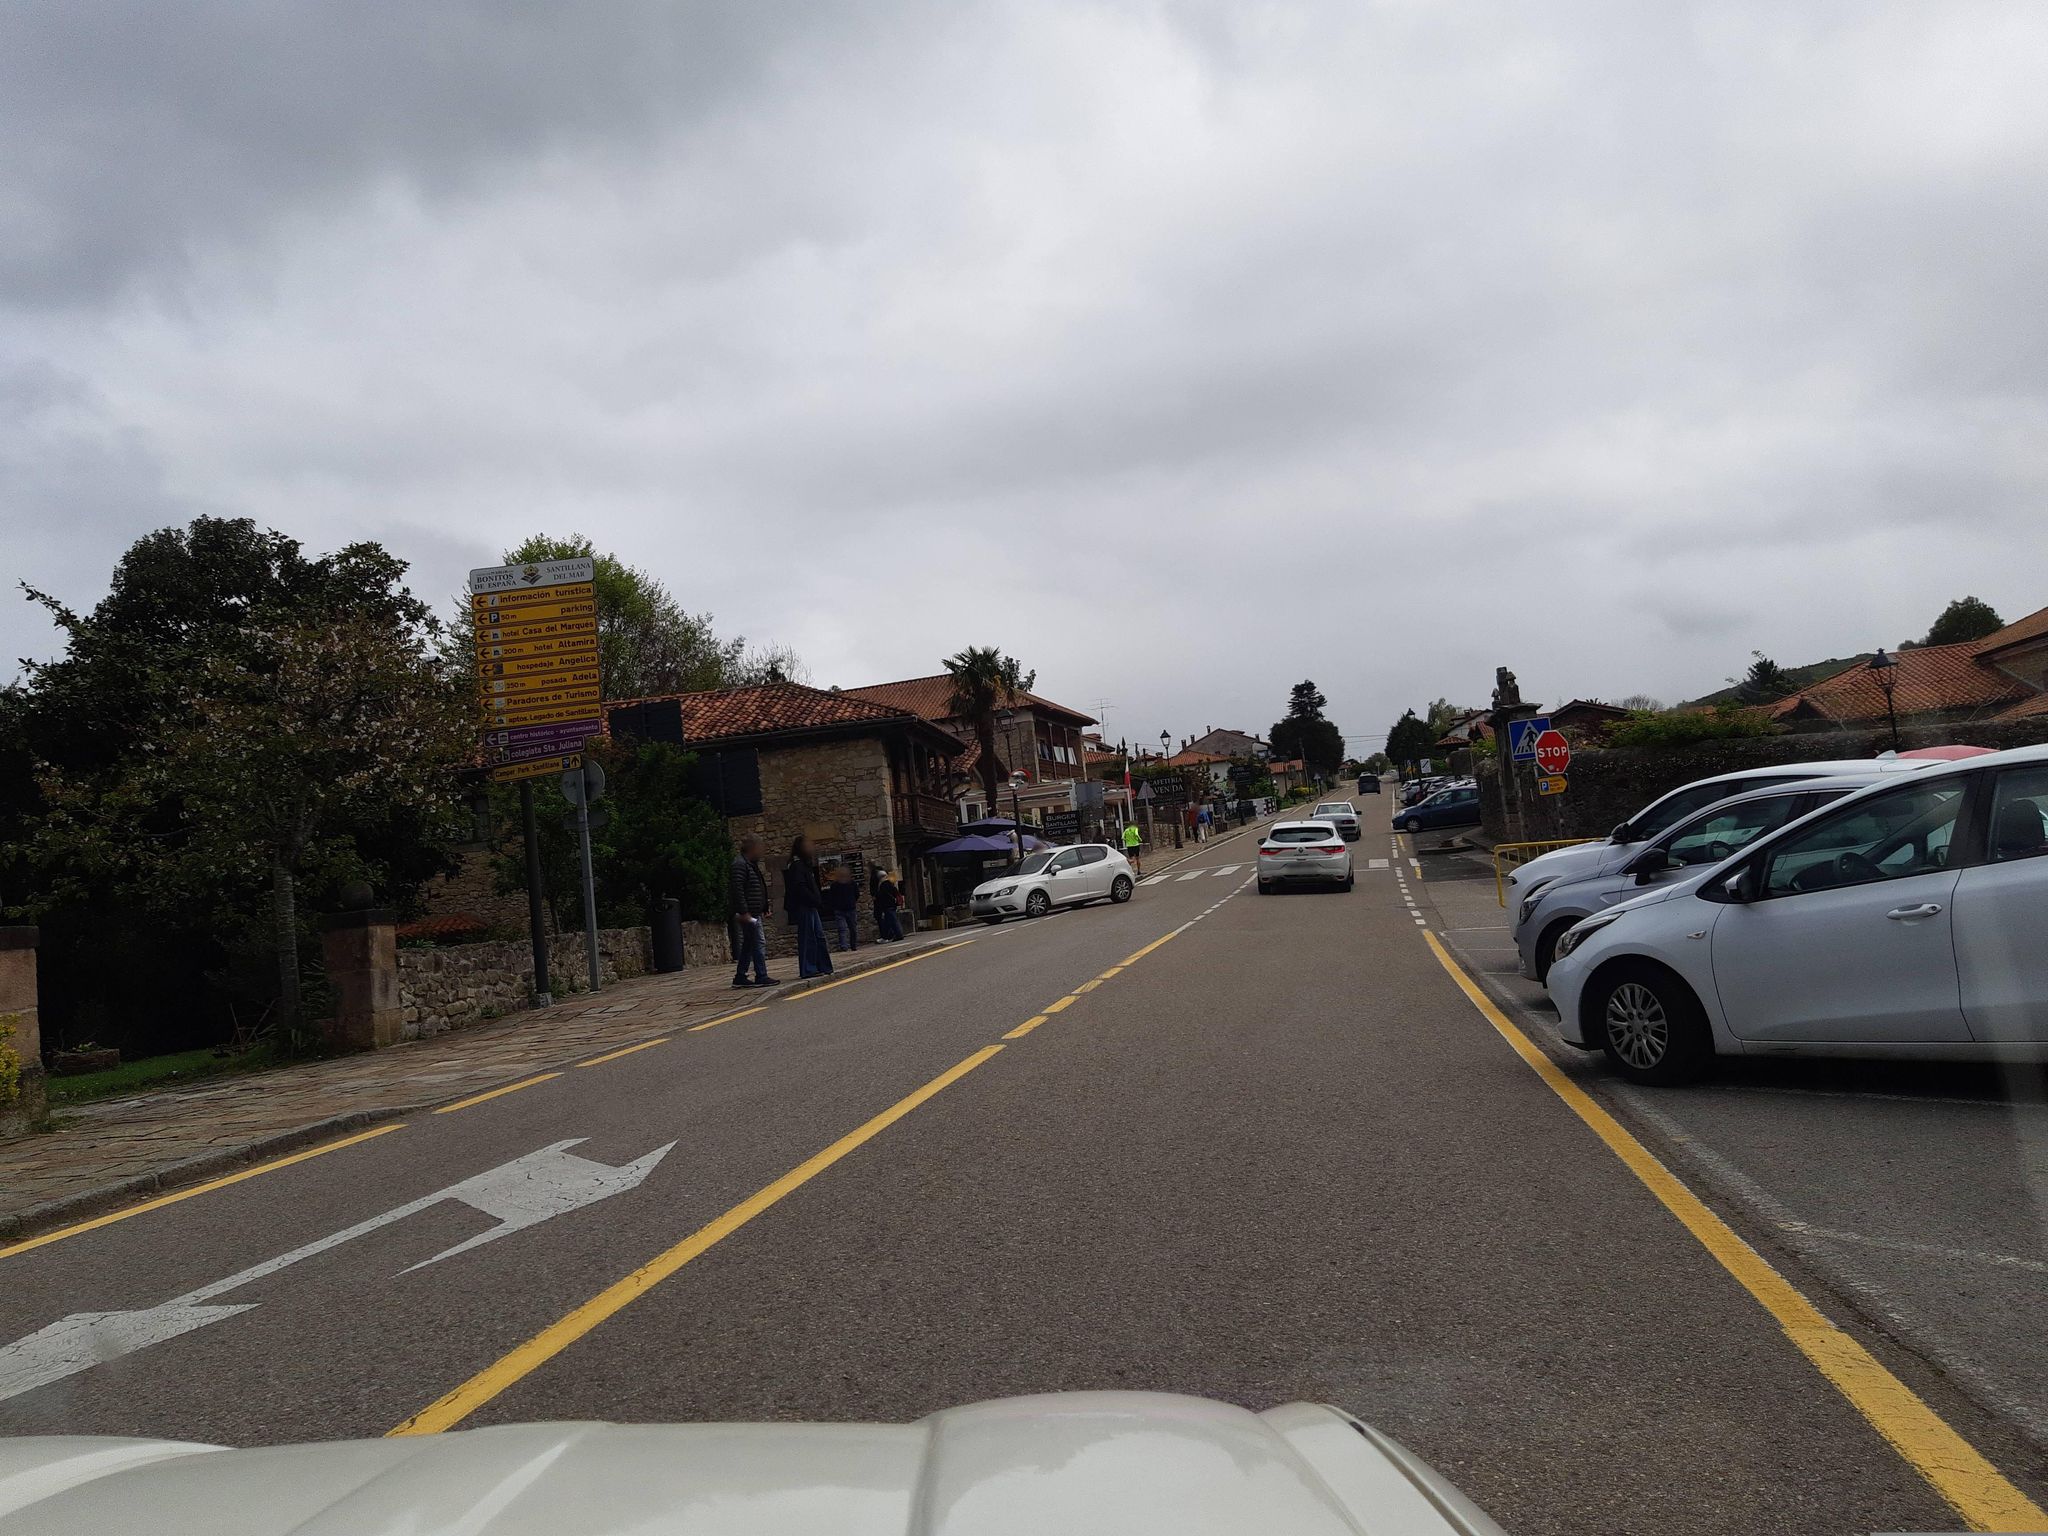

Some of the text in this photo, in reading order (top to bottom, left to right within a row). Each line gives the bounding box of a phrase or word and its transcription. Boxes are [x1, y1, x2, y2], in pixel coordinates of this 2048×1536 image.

[546, 562, 591, 573] SANTILLANA
[476, 574, 514, 583] BONITOS
[569, 571, 585, 579] MAR
[488, 579, 517, 589] ESPAÑA
[560, 604, 593, 616] parking
[502, 630, 520, 638] hotel
[522, 625, 542, 635] Casa
[545, 624, 557, 633] del
[534, 643, 553, 651] hotel
[558, 638, 595, 648] Altamira
[516, 660, 554, 670] hospedaje
[541, 677, 567, 686] posada
[572, 672, 598, 681] Adela
[507, 695, 550, 706] Paradores
[564, 689, 598, 699] Turismo
[529, 713, 555, 721] Legado
[565, 707, 600, 716] Santillana
[510, 732, 529, 740] centro
[560, 724, 598, 734] ayuntamiento
[511, 746, 542, 758] colegiata
[559, 740, 582, 751] Juliana
[1537, 746, 1567, 758] STOP
[533, 762, 560, 771] Santillana
[1046, 819, 1078, 828] SANTILLANA
